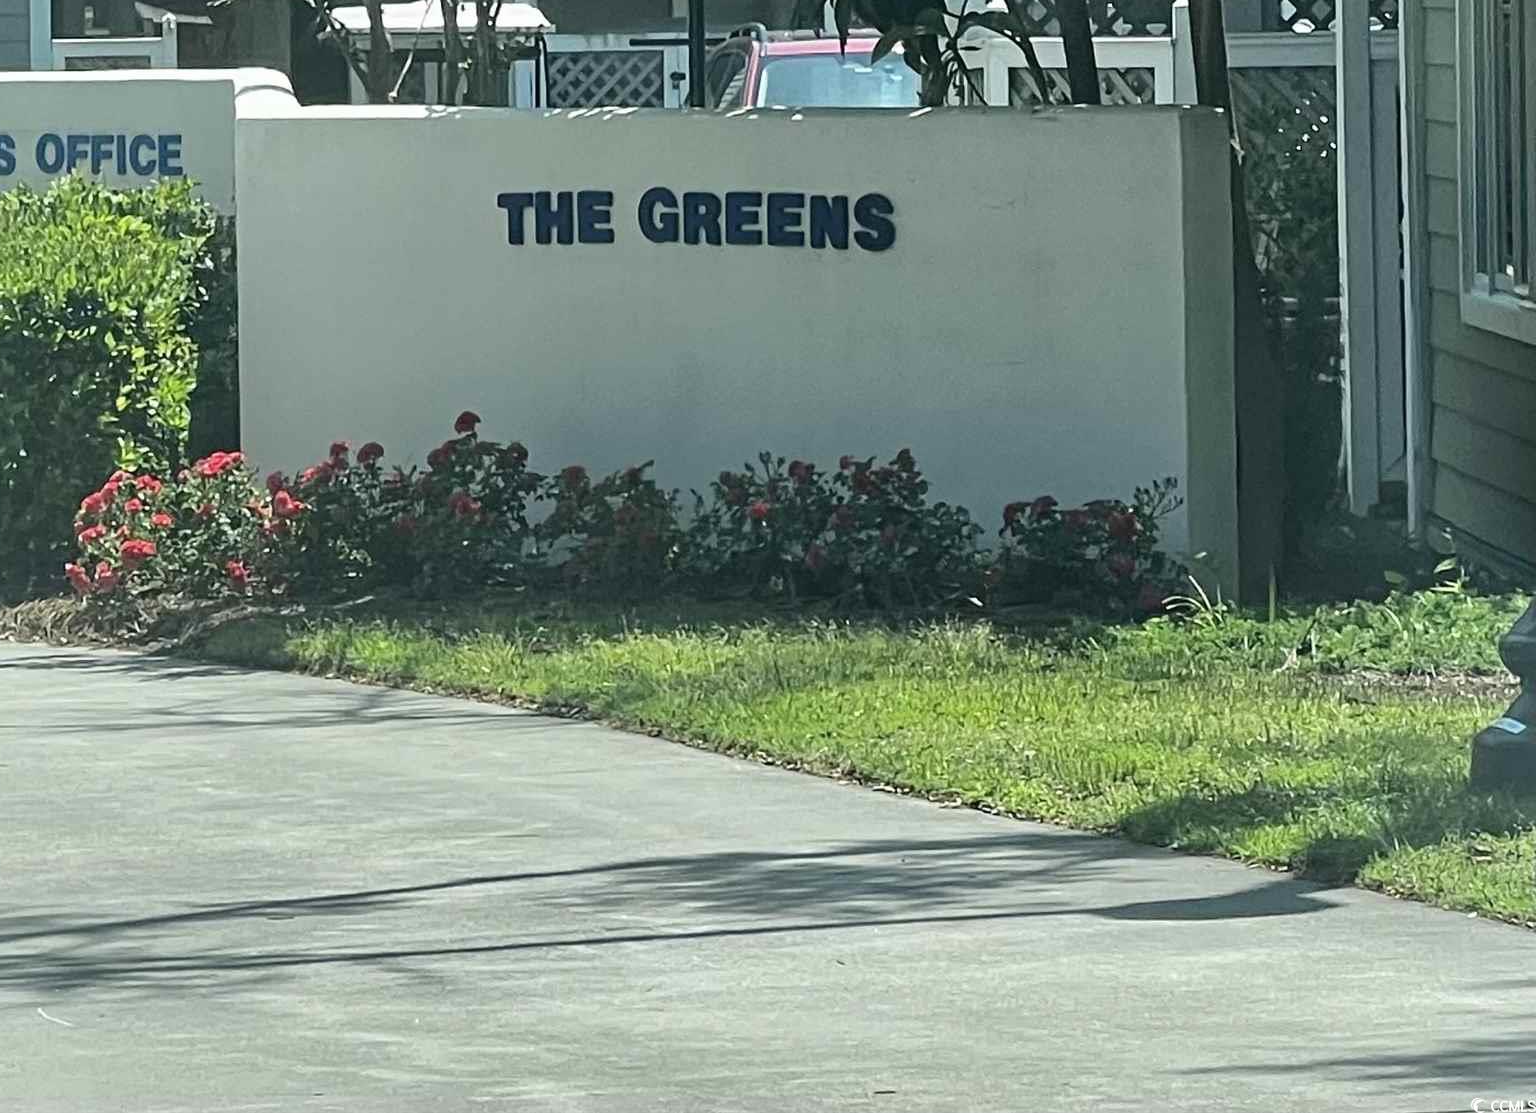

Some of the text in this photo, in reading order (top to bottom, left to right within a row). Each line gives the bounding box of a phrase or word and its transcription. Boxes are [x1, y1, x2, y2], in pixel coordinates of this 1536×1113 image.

[35, 132, 184, 176] OFFICE
[496, 186, 897, 252] THE GREENS
